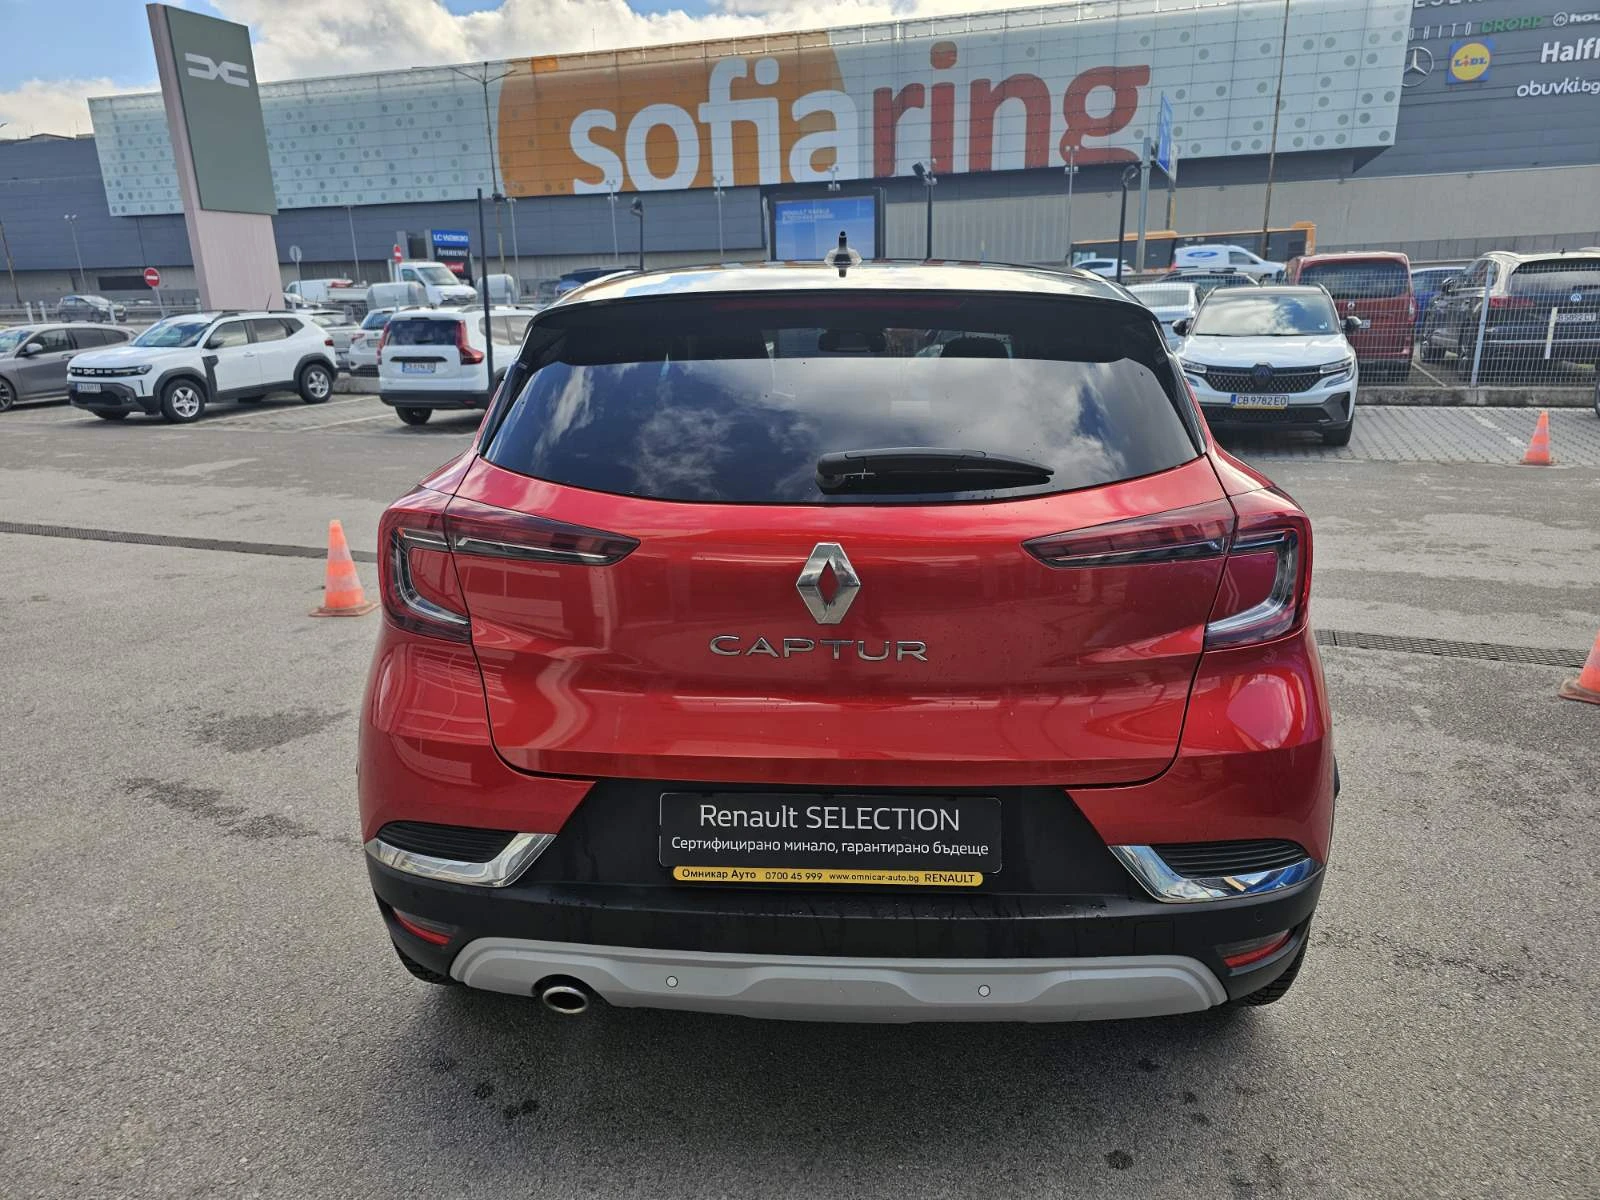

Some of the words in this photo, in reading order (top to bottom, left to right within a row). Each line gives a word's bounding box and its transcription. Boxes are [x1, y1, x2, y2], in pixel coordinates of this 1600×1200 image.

[1517, 76, 1600, 97] obuvki.bg
[709, 635, 928, 662] CAPTUR
[700, 804, 799, 828] Renault
[806, 805, 960, 831] SELECTION
[671, 836, 781, 853] Сертифицирано
[784, 841, 839, 854] минало,
[841, 842, 930, 856] гарантирано
[933, 841, 989, 857] бъдеще
[682, 868, 728, 880] Омникар
[731, 870, 757, 881] Ауто
[765, 872, 788, 880] 0700
[791, 872, 802, 880] 45
[805, 872, 823, 881] 999
[829, 873, 919, 883] www.omnicar-auto.bg
[924, 873, 975, 884] RENAULT
